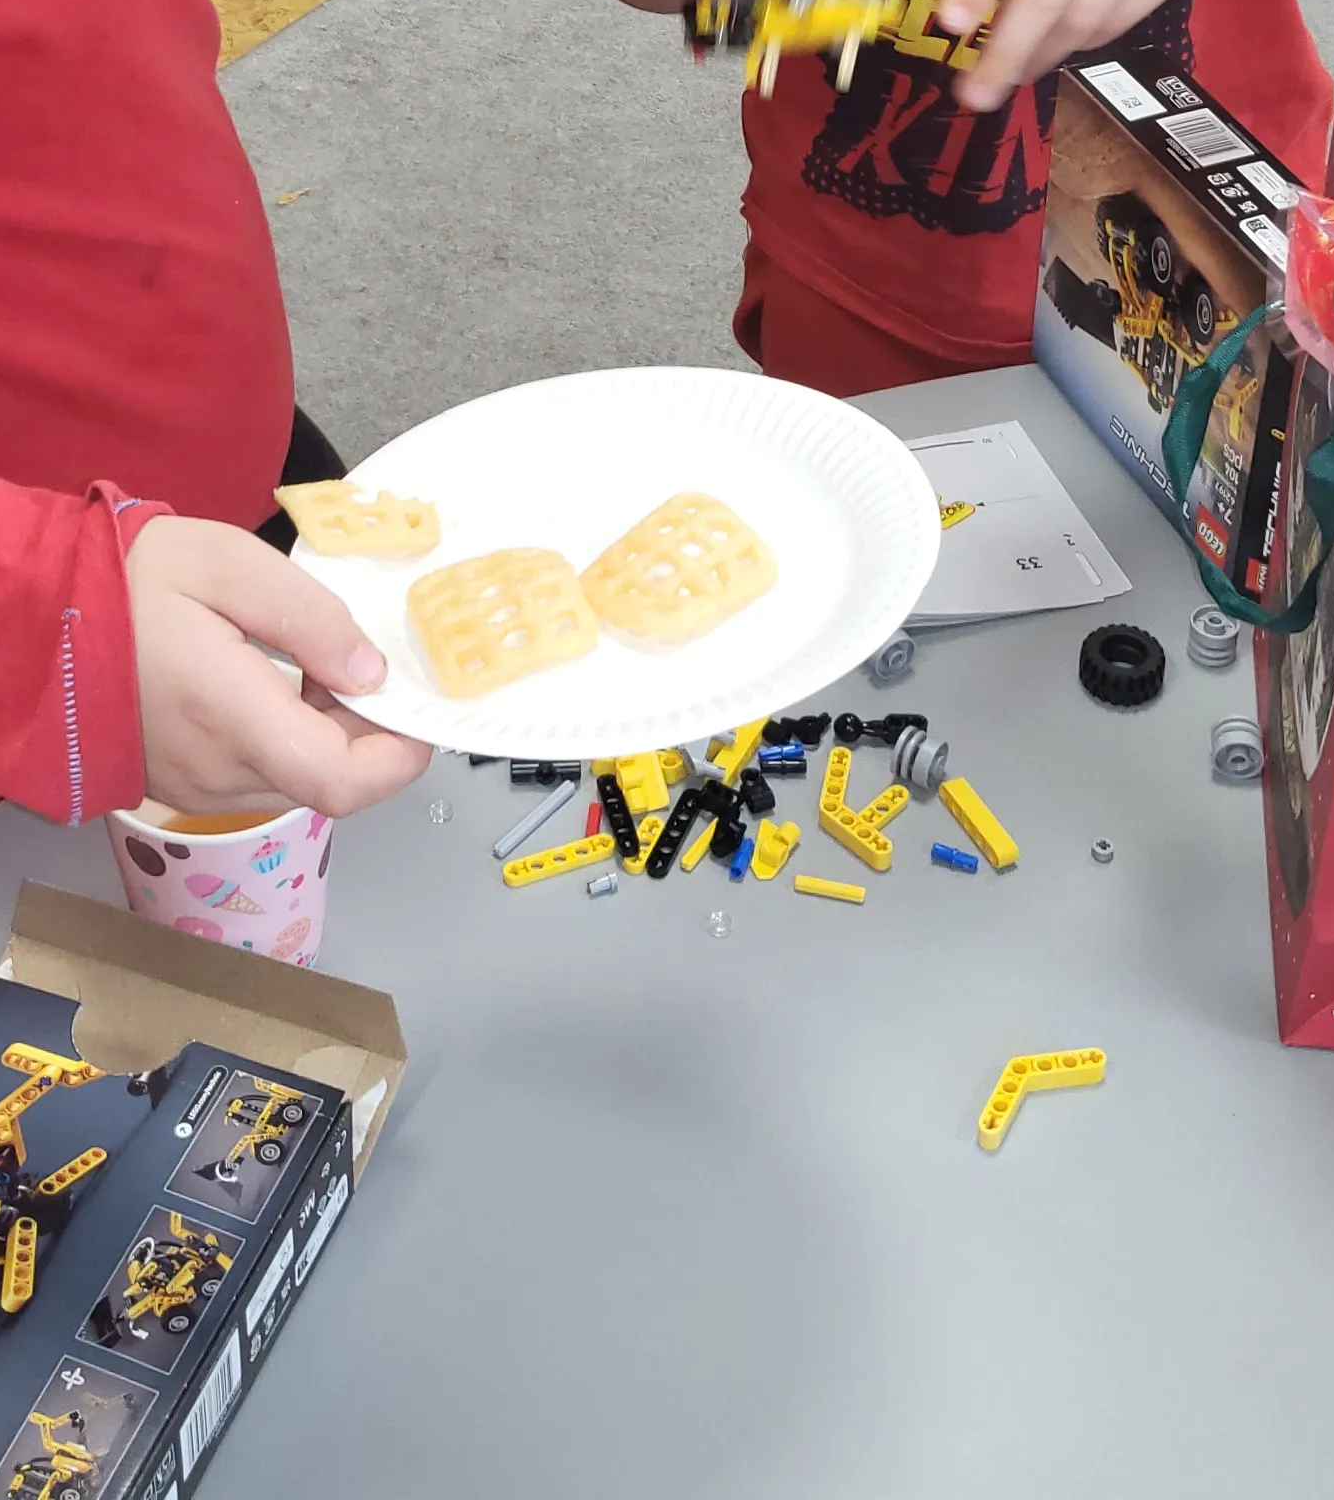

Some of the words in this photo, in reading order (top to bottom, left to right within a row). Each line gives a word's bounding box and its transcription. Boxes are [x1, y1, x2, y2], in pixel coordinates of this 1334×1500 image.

[1222, 442, 1244, 471] pcs
[1216, 501, 1233, 527] 7+
[1198, 520, 1225, 556] LEGO
[1015, 556, 1044, 571] 33
